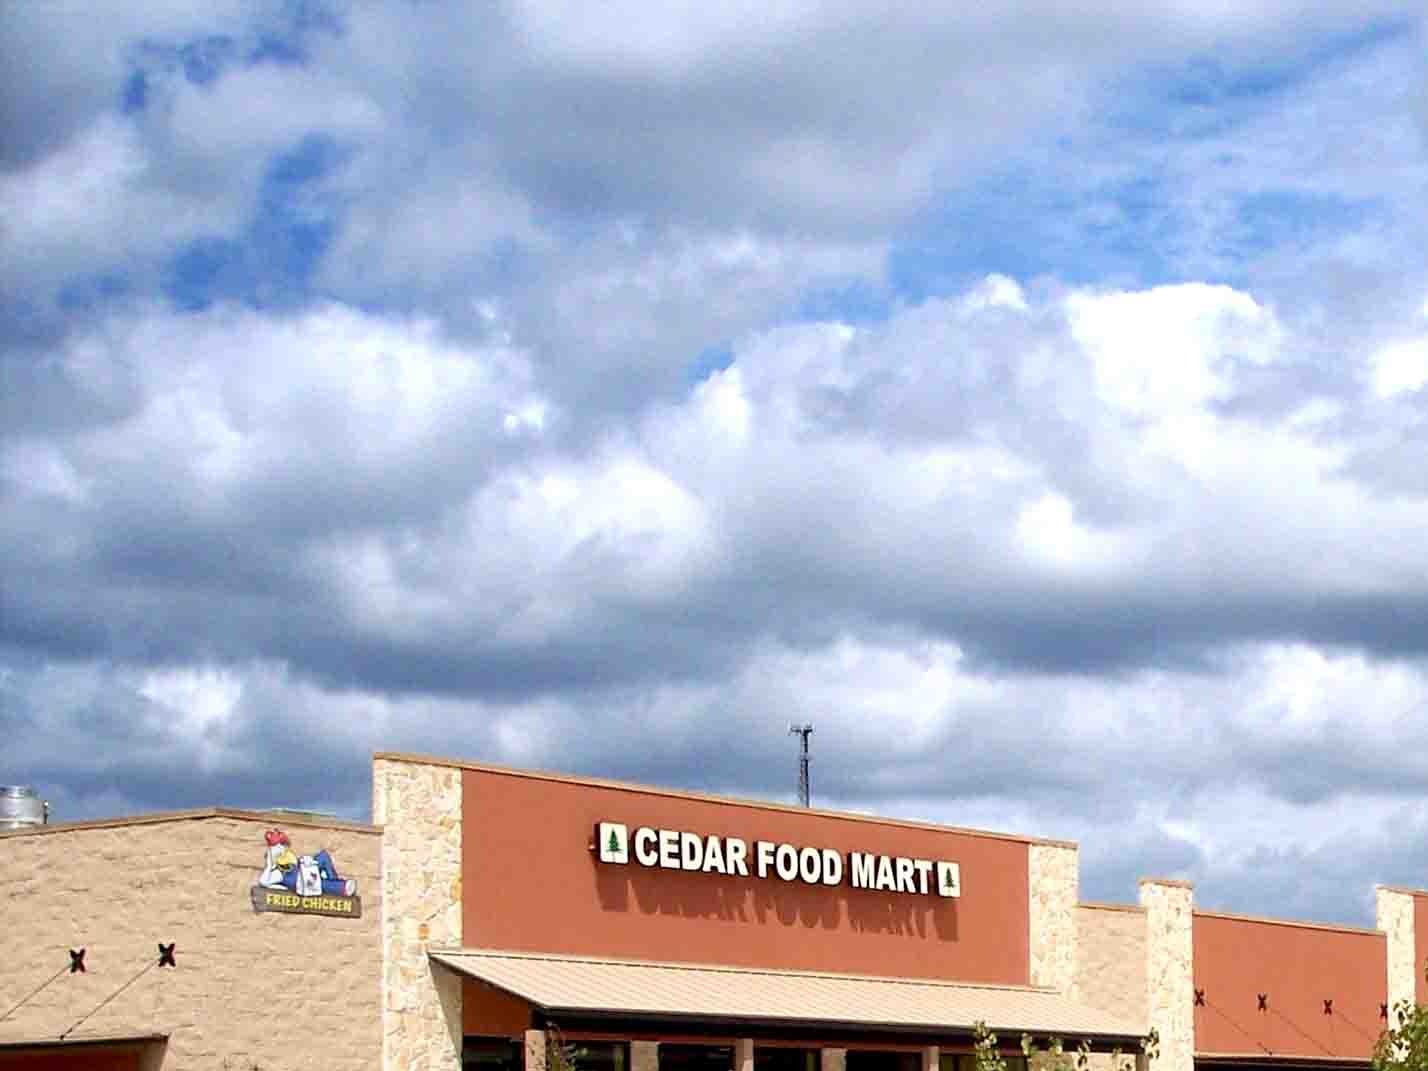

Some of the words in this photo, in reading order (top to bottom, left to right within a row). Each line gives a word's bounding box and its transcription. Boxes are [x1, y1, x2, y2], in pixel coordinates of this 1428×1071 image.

[634, 827, 750, 876] CEDAR
[757, 841, 843, 886] FOOD
[851, 852, 933, 895] MART
[266, 894, 300, 907] FRIED
[302, 897, 353, 913] CHICKEN
